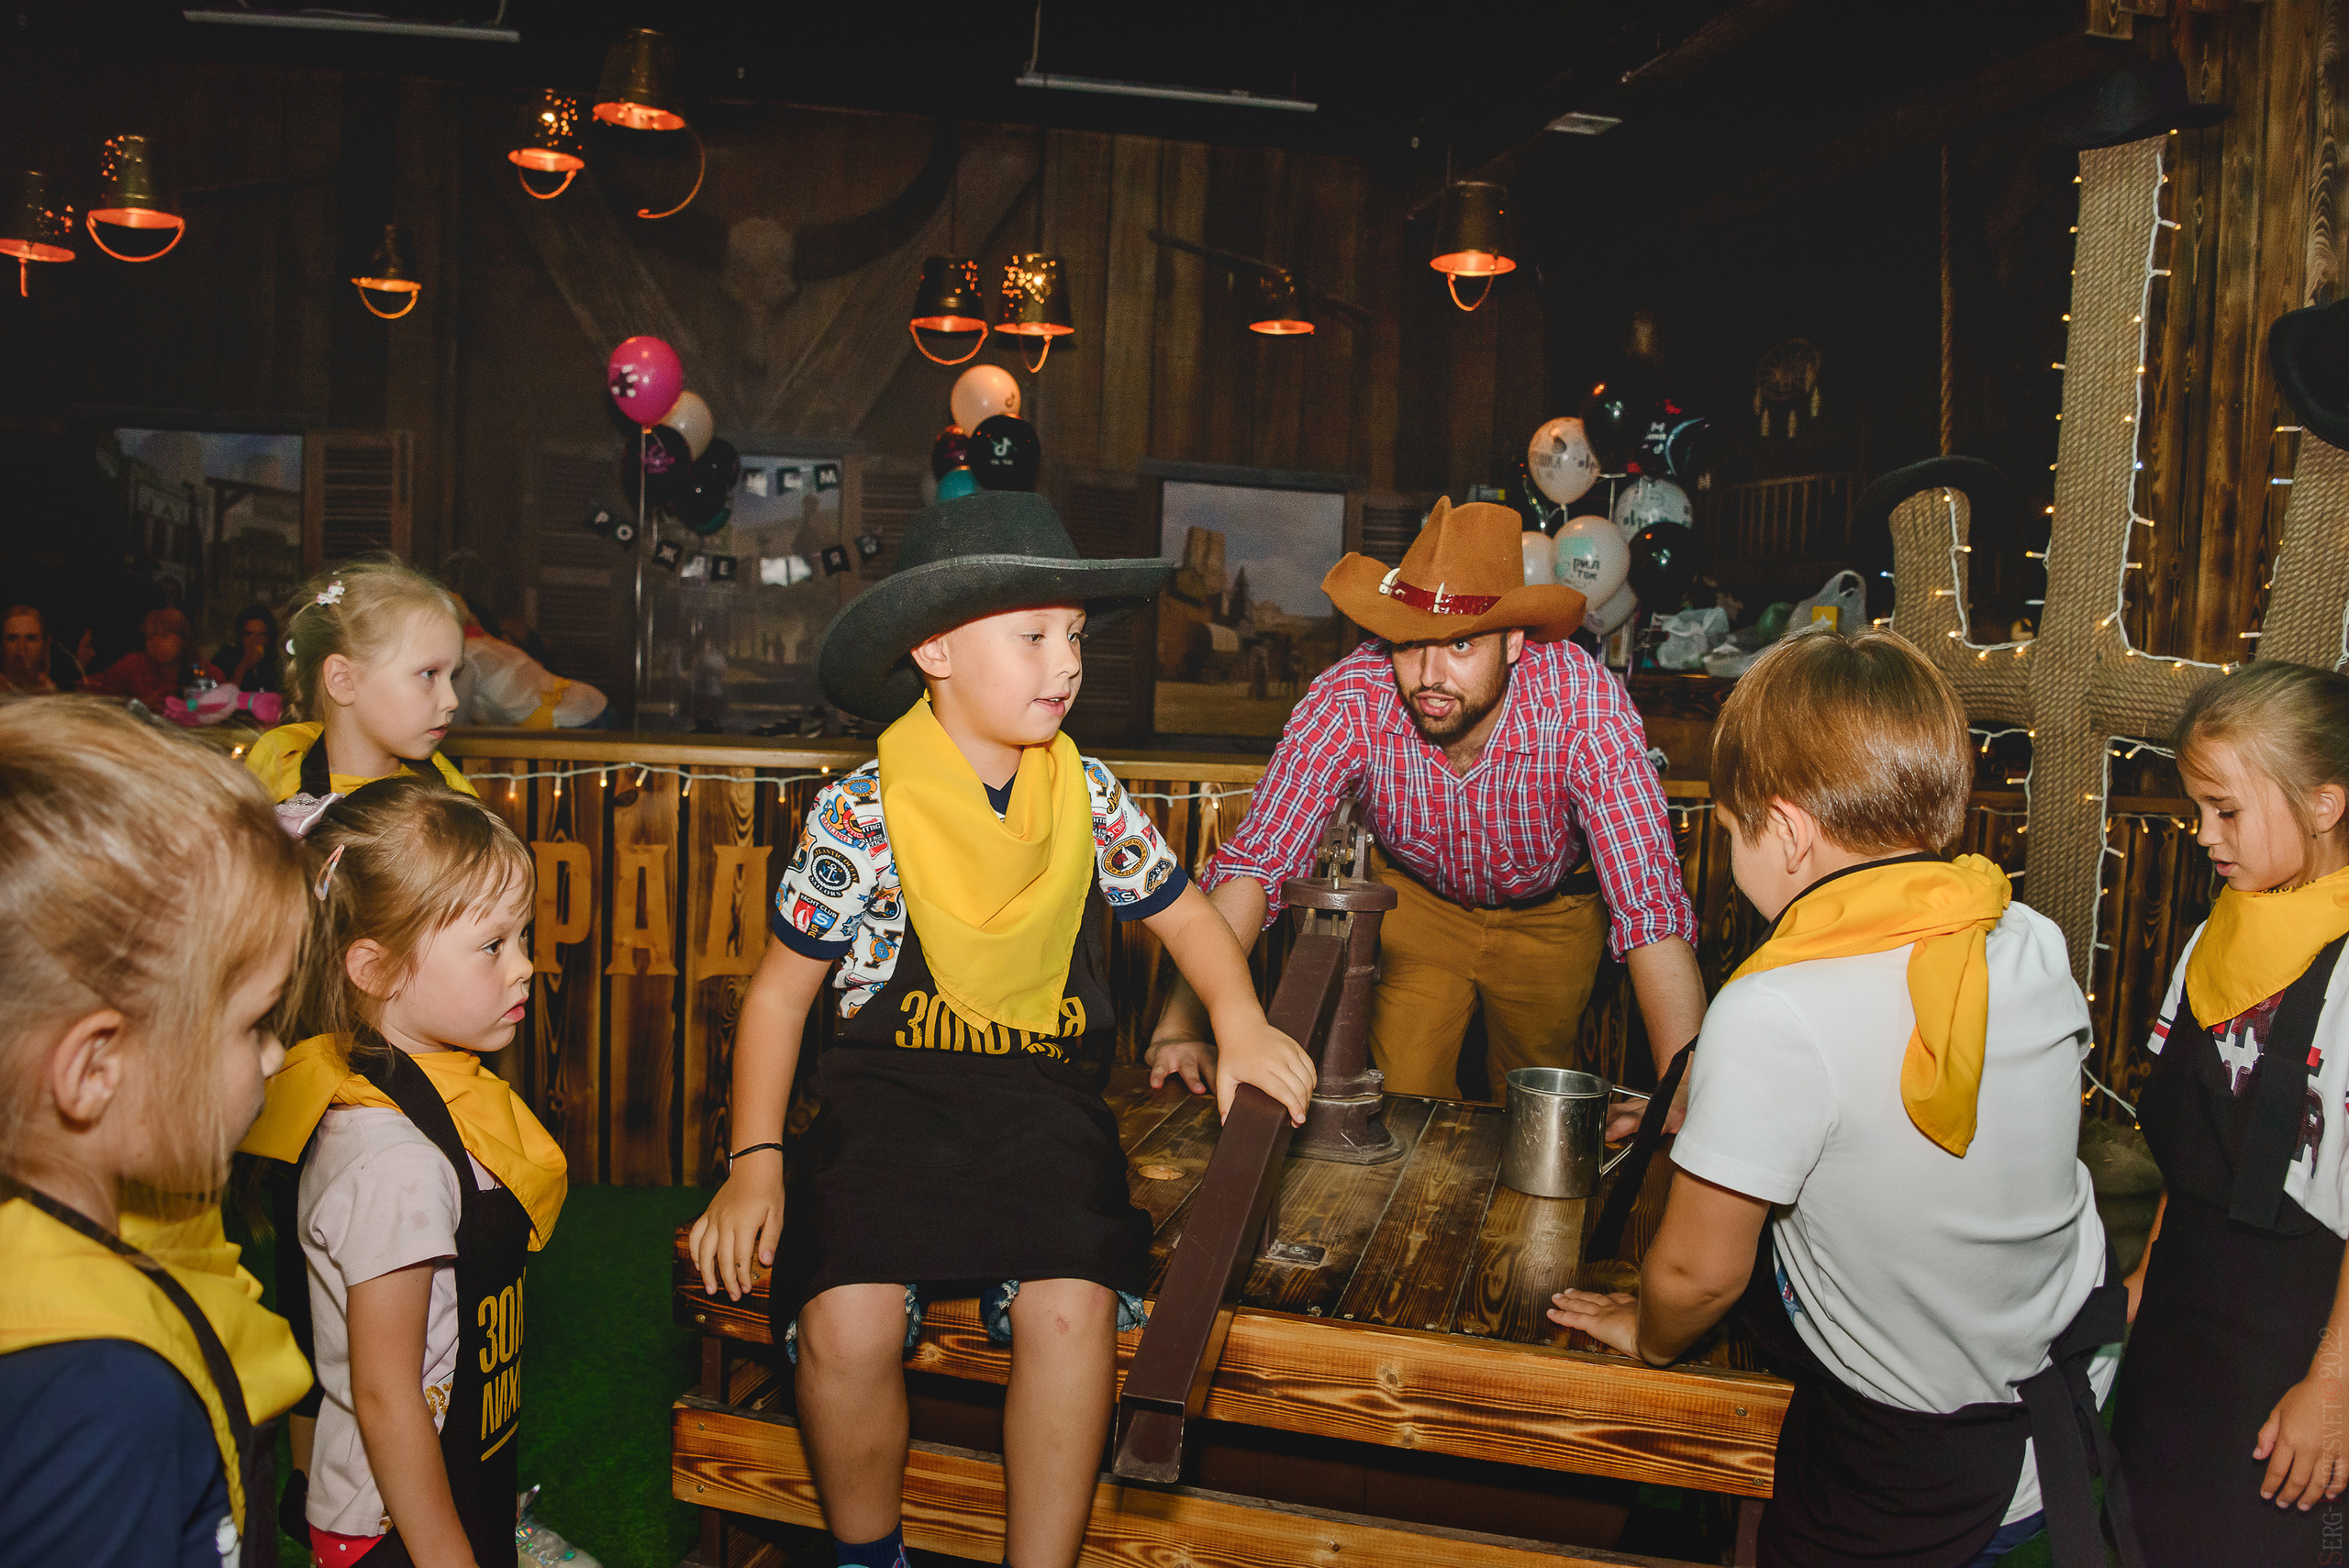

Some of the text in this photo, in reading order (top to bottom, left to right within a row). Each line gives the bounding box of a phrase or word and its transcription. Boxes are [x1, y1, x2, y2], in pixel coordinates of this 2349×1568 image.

[842, 857, 859, 882] OCEAN
[809, 876, 842, 897] SAILORS
[799, 894, 838, 918] YACHT CLUB
[477, 1267, 526, 1373] ЗОЛ
